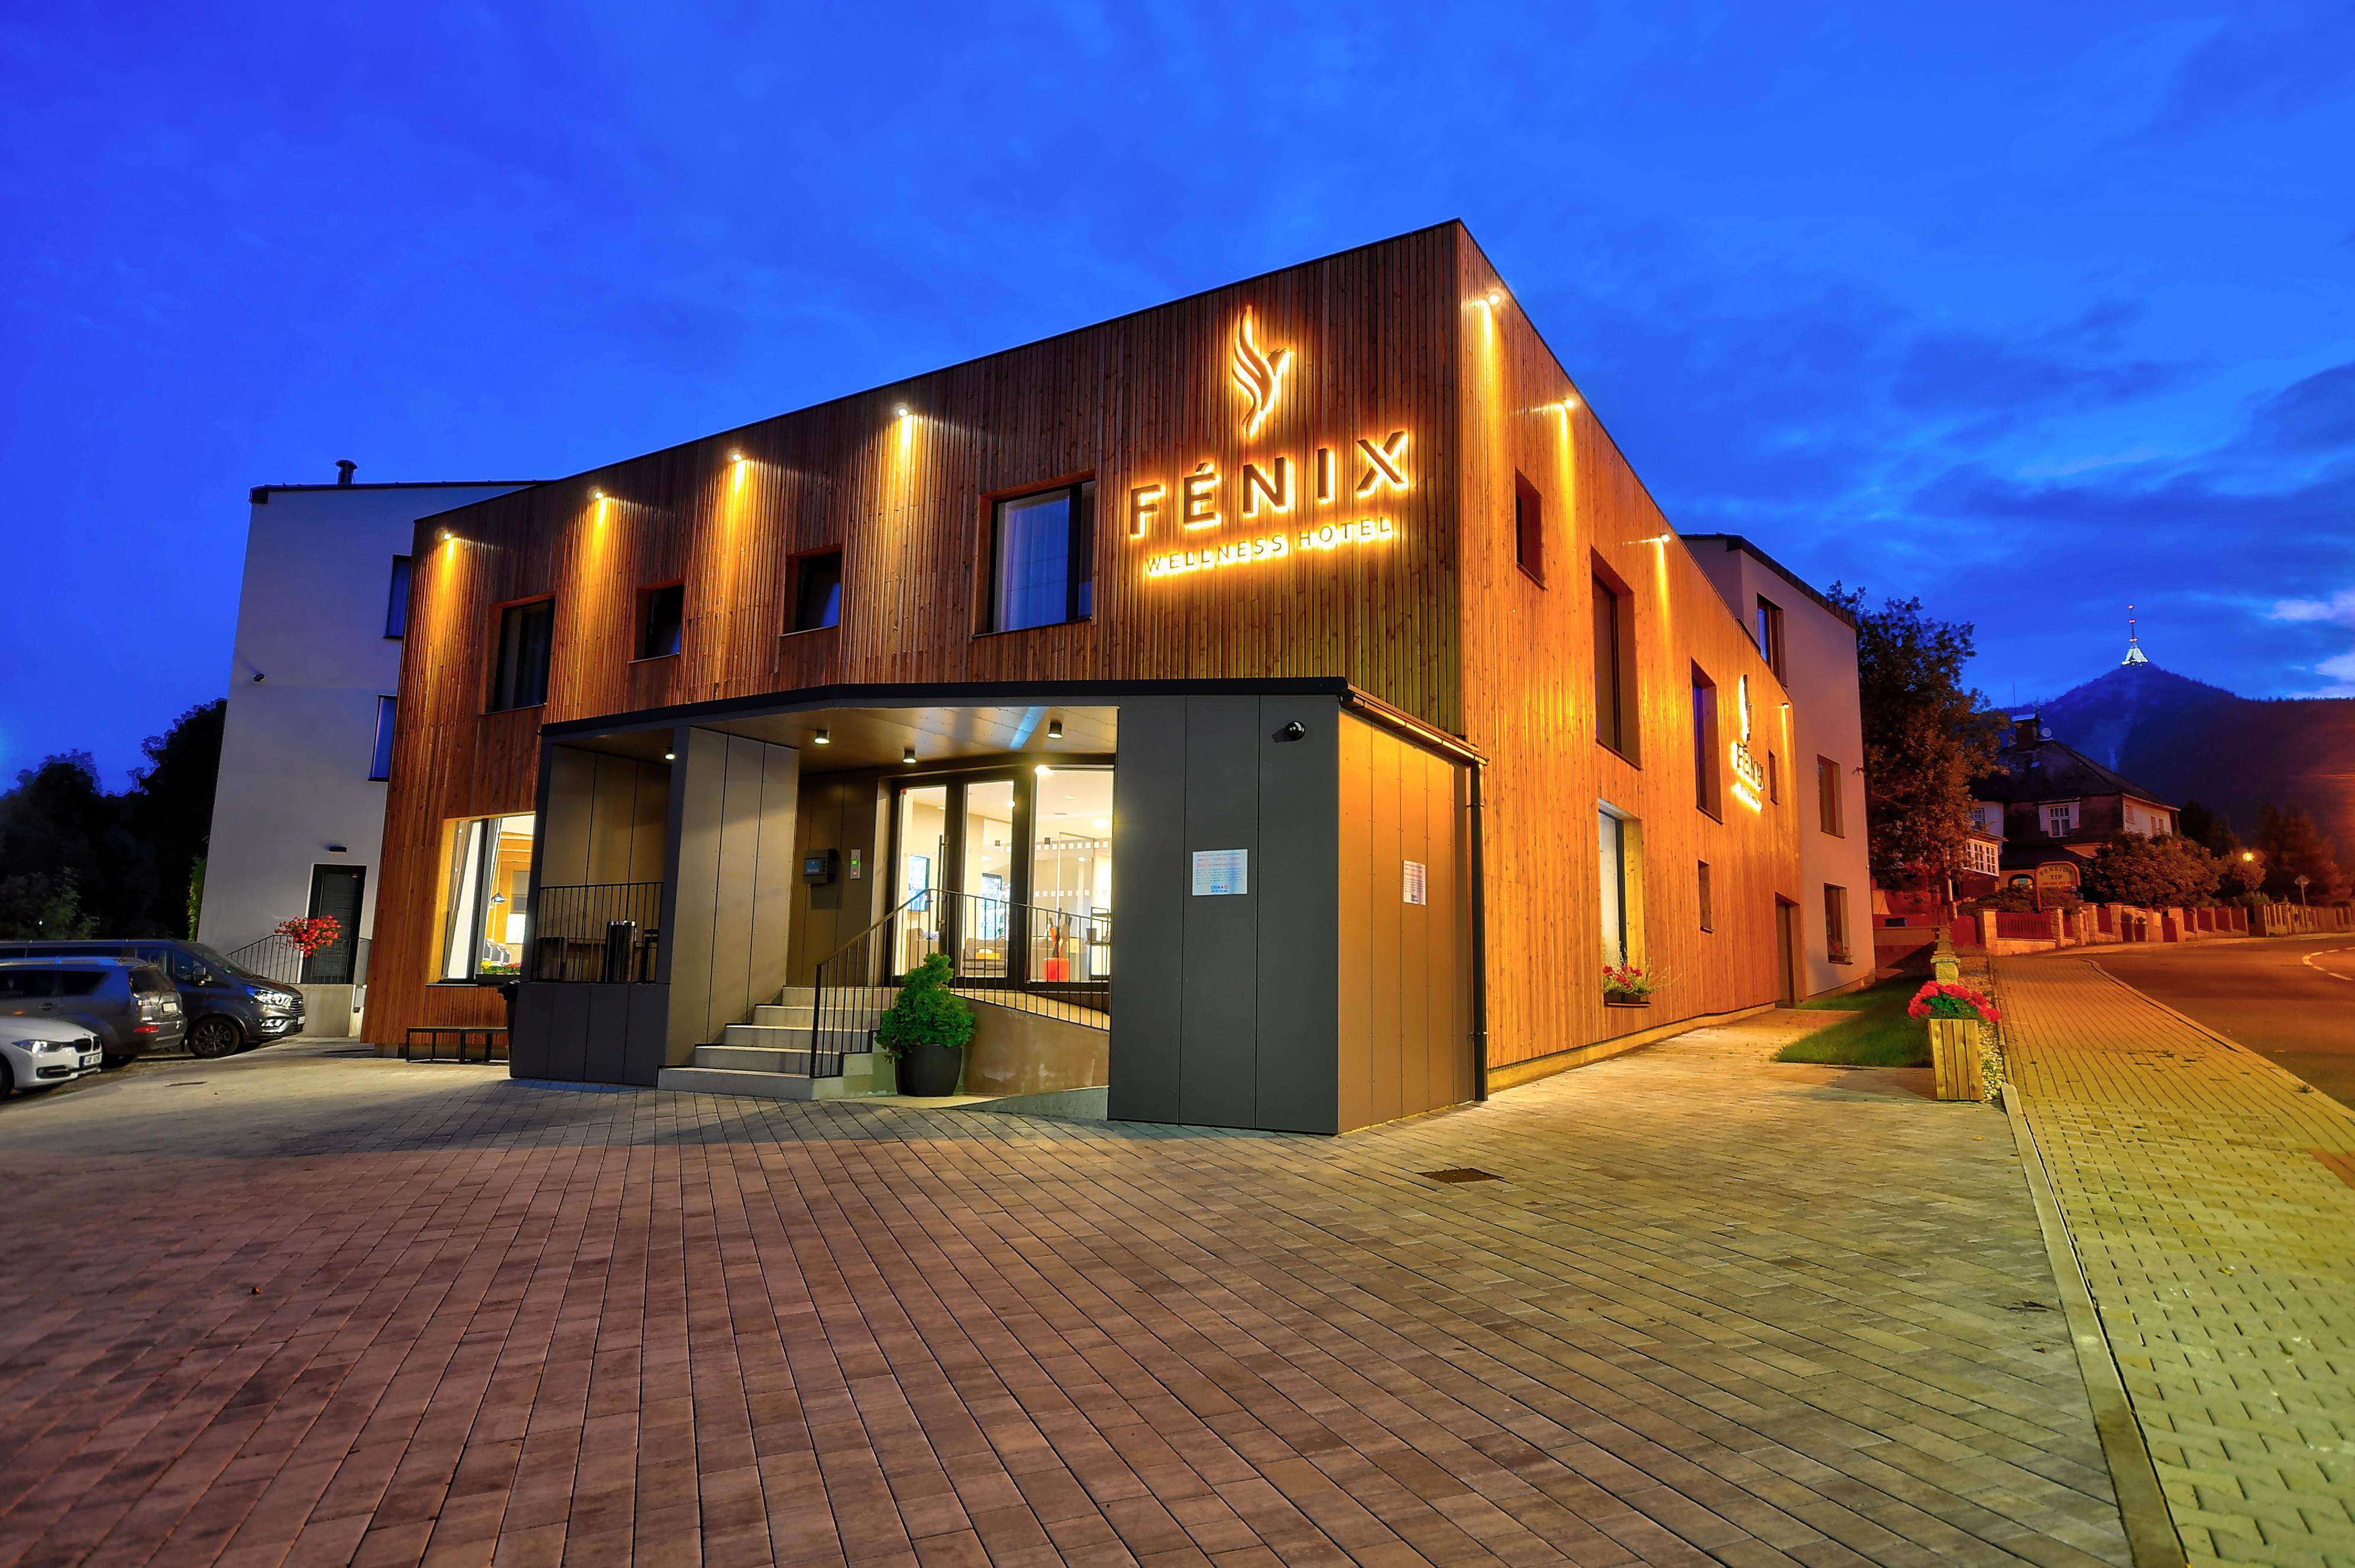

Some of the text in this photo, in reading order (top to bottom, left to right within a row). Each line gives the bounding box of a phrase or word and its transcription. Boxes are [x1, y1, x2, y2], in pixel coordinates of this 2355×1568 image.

[1129, 430, 1406, 536] FÉNIX
[1145, 516, 1392, 574] WELLNESS HOTEL
